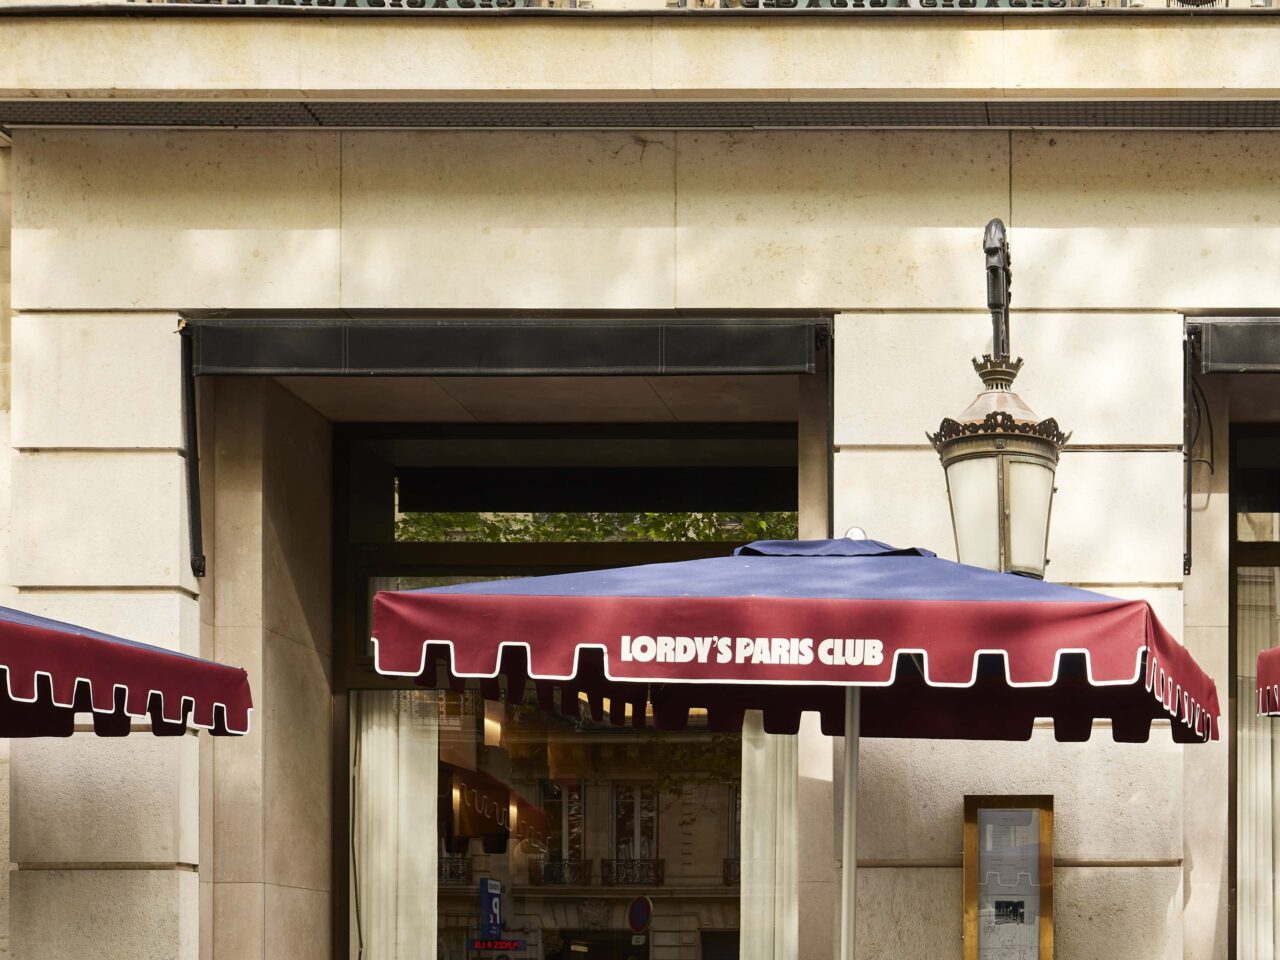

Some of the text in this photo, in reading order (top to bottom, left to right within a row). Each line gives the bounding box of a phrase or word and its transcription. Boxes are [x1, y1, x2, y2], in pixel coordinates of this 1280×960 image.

[621, 635, 884, 666] LORDY'S PARIS CLUB
